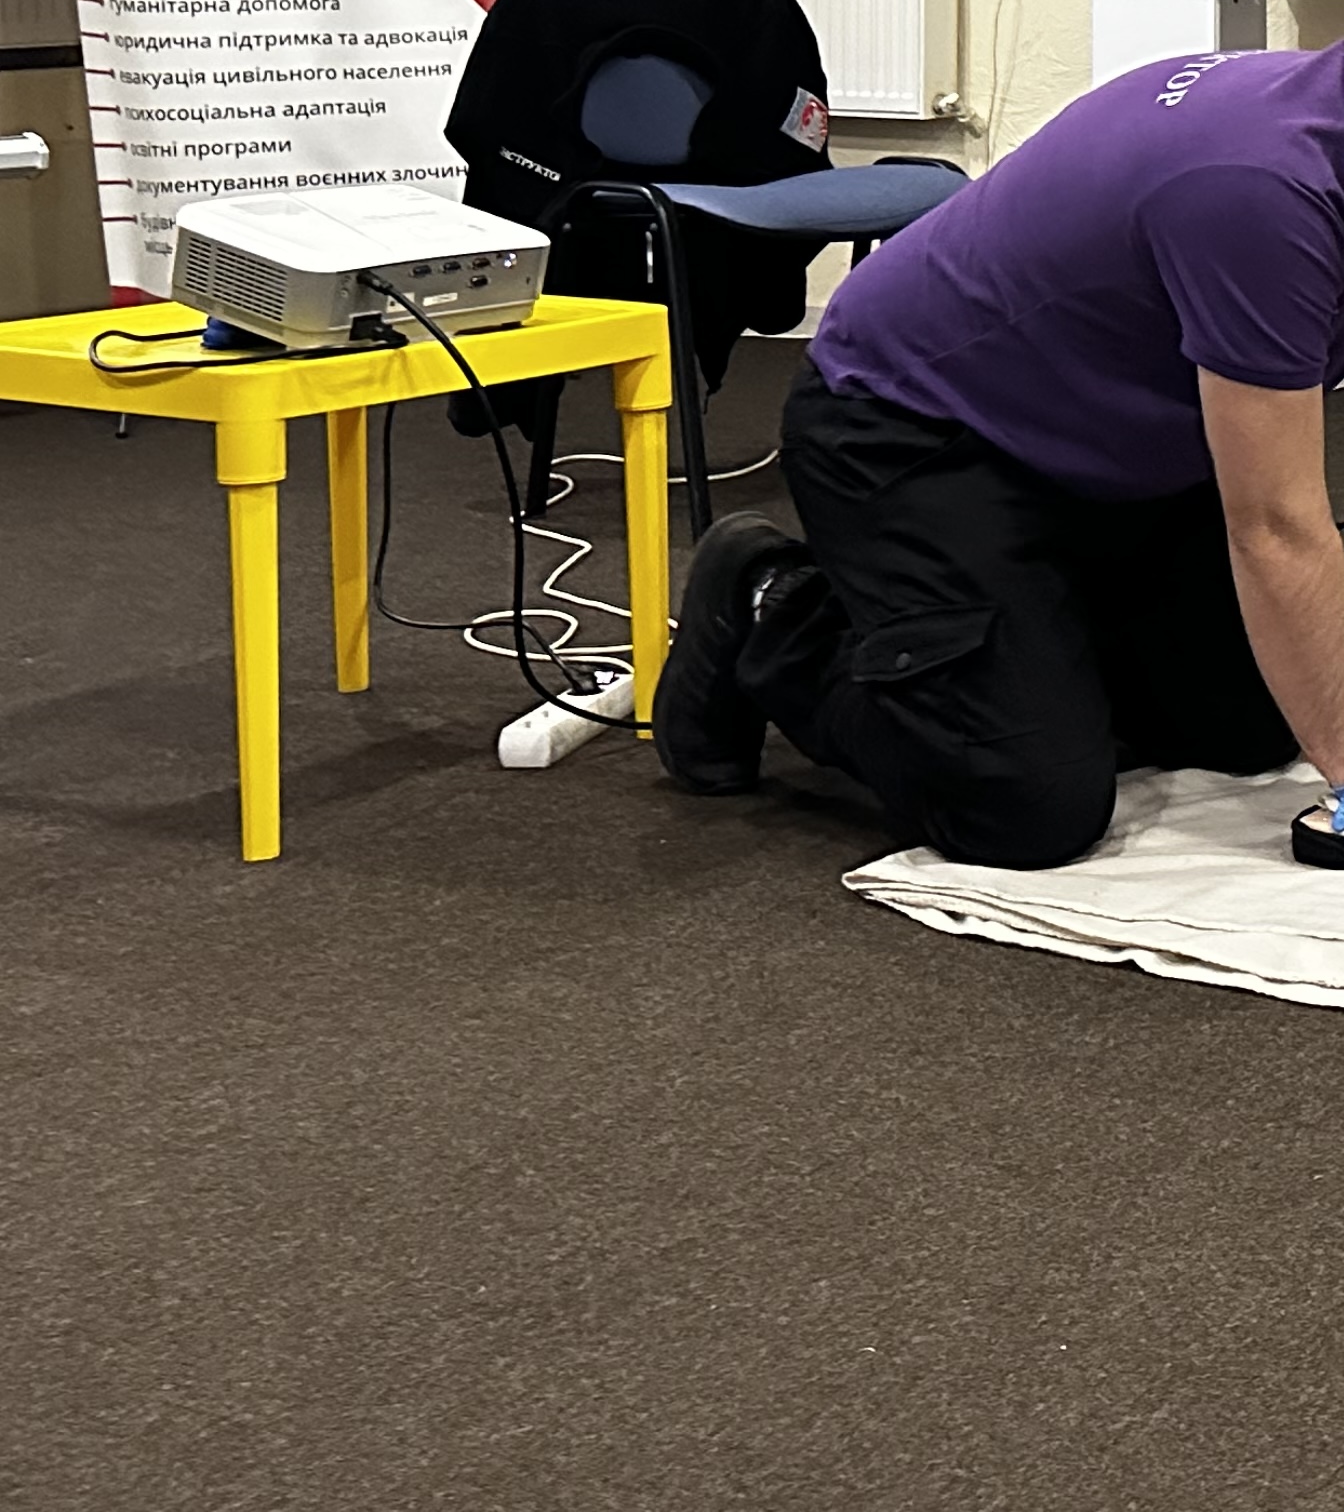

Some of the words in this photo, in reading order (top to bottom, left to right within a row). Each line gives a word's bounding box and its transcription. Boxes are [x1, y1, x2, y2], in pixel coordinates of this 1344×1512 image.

[218, 31, 333, 51] підтримка
[338, 34, 358, 45] та
[364, 26, 468, 48] адвокація
[213, 67, 337, 86] цивільного
[343, 63, 452, 80] населення
[282, 98, 387, 119] адаптація
[184, 139, 292, 160] програми
[296, 170, 387, 187] воєнних
[391, 165, 469, 182] злочин
